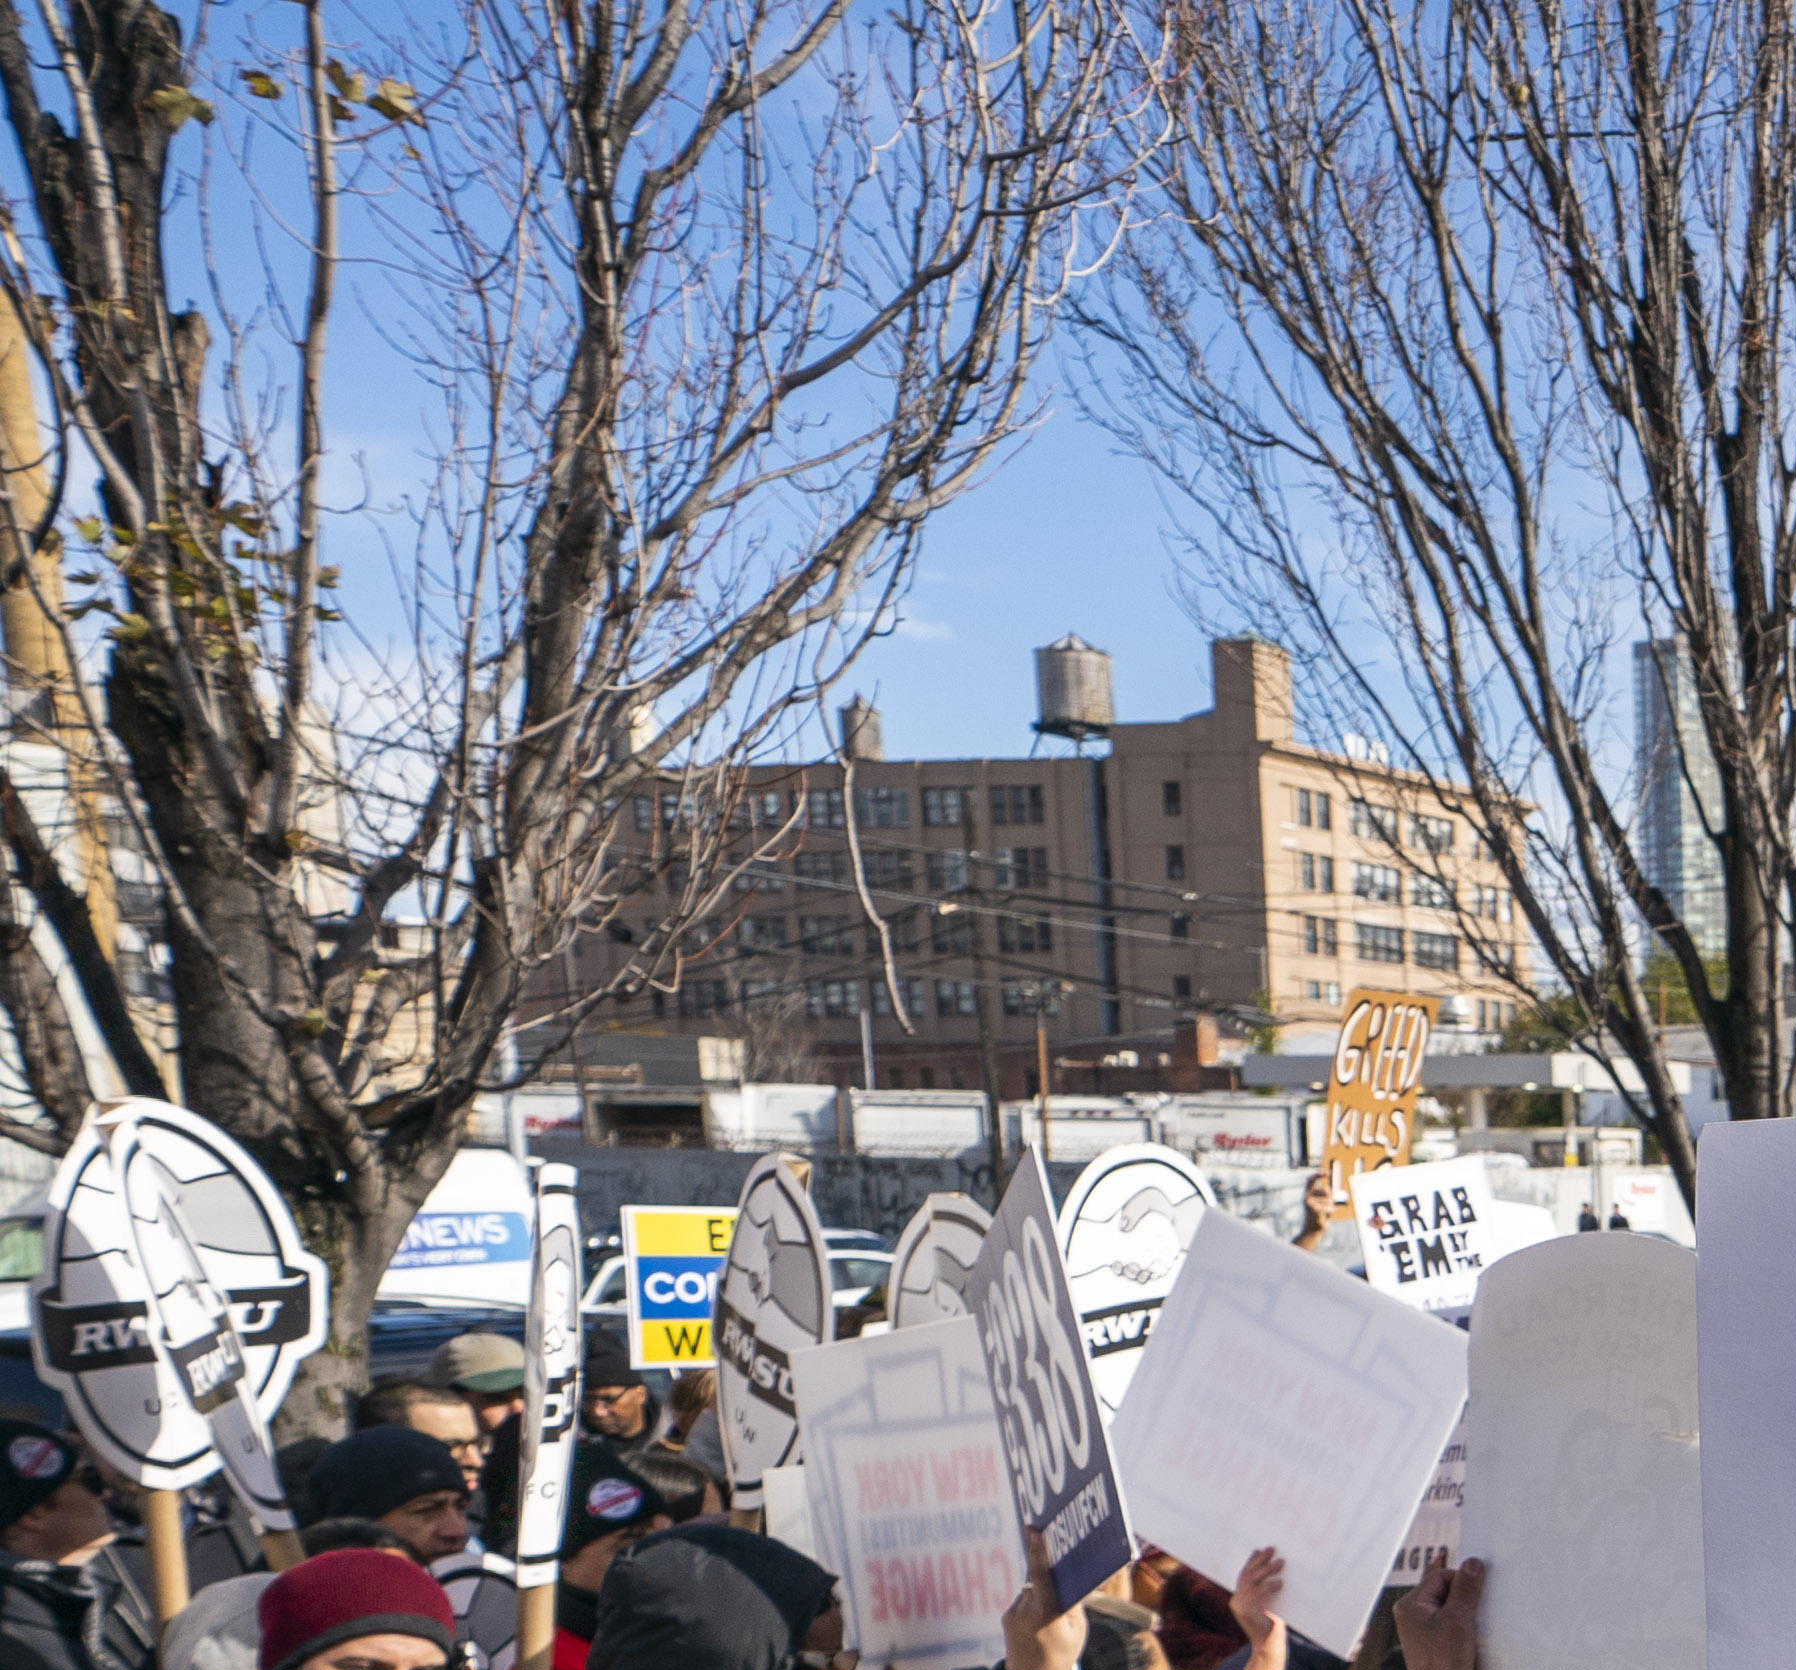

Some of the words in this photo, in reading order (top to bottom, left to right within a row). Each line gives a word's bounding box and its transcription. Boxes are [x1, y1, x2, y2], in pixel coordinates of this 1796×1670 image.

[1335, 999, 1430, 1101] GREED
[1329, 1102, 1407, 1157] KILLS
[1369, 1186, 1478, 1240] GRAB
[1379, 1233, 1453, 1284] 'EM
[987, 1215, 1092, 1517] 338
